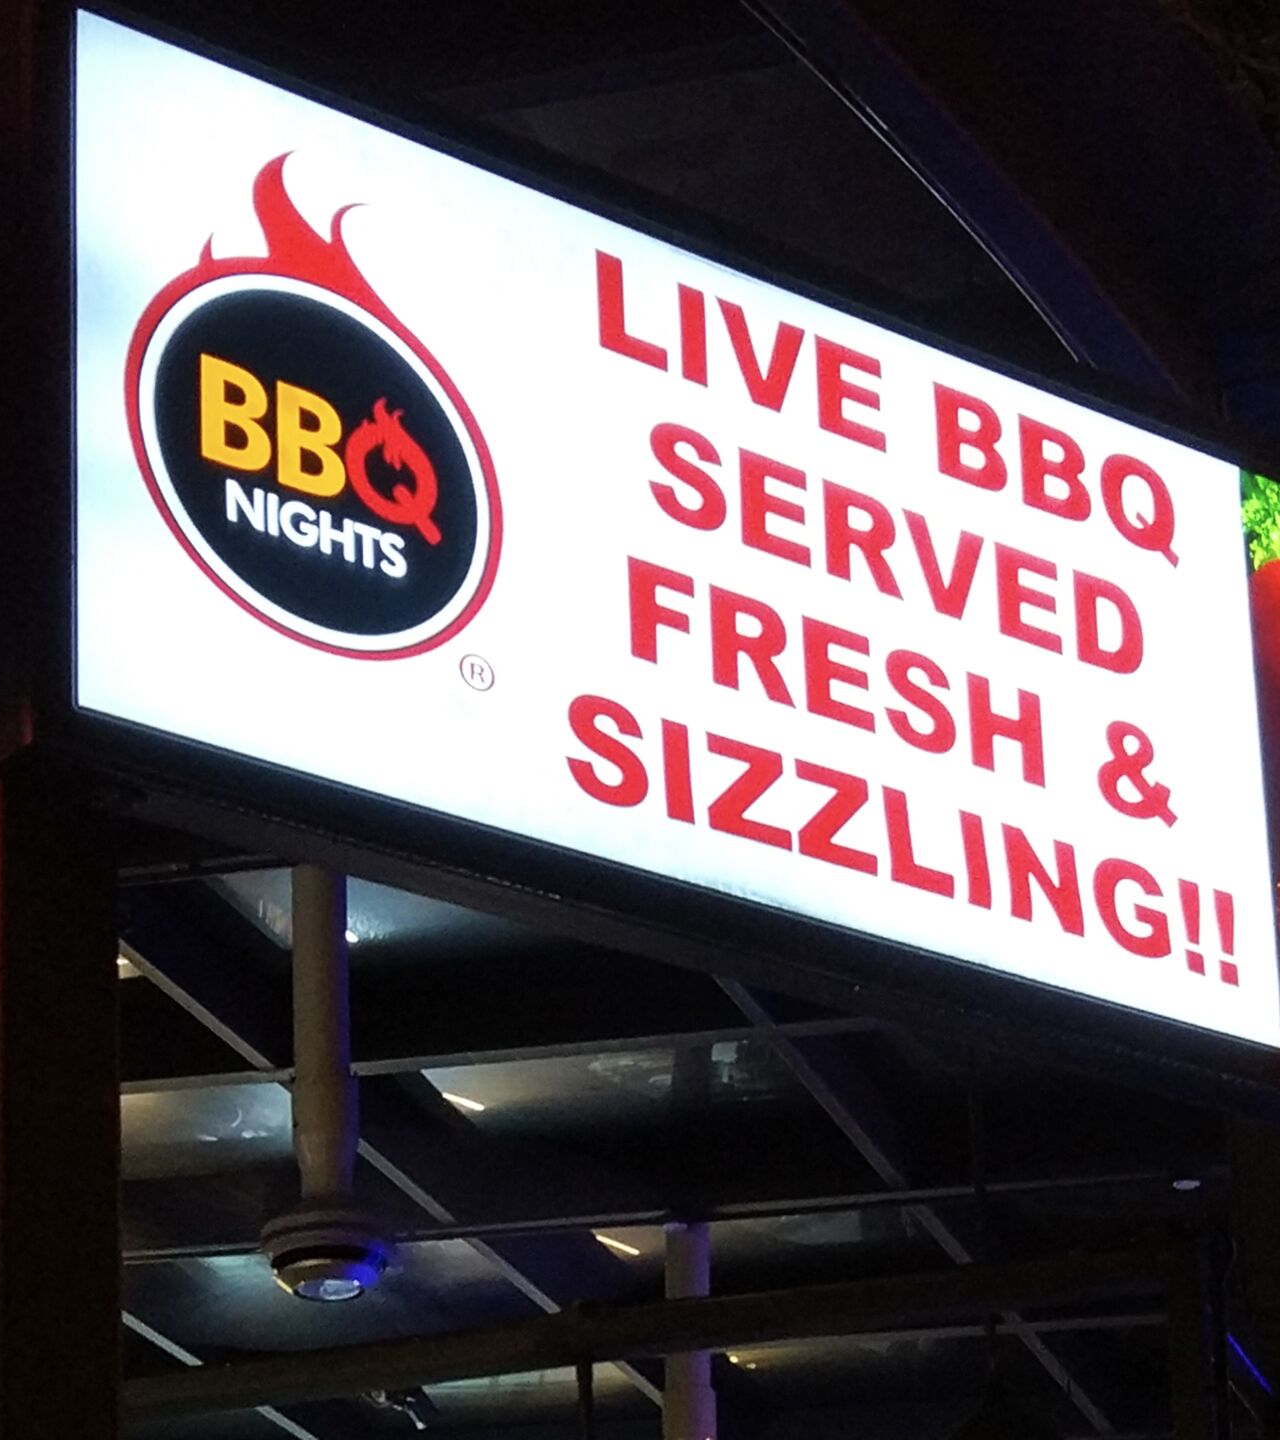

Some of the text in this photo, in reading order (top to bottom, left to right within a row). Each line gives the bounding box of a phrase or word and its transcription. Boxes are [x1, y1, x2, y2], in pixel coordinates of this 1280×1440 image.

[199, 352, 443, 547] BBQ
[224, 477, 409, 580] NIGHTS
[595, 247, 1180, 568] LIVE BBQ
[647, 421, 1145, 675] SERVED
[626, 554, 1179, 828] FRESH &
[564, 692, 1241, 988] SIZZLING!!
